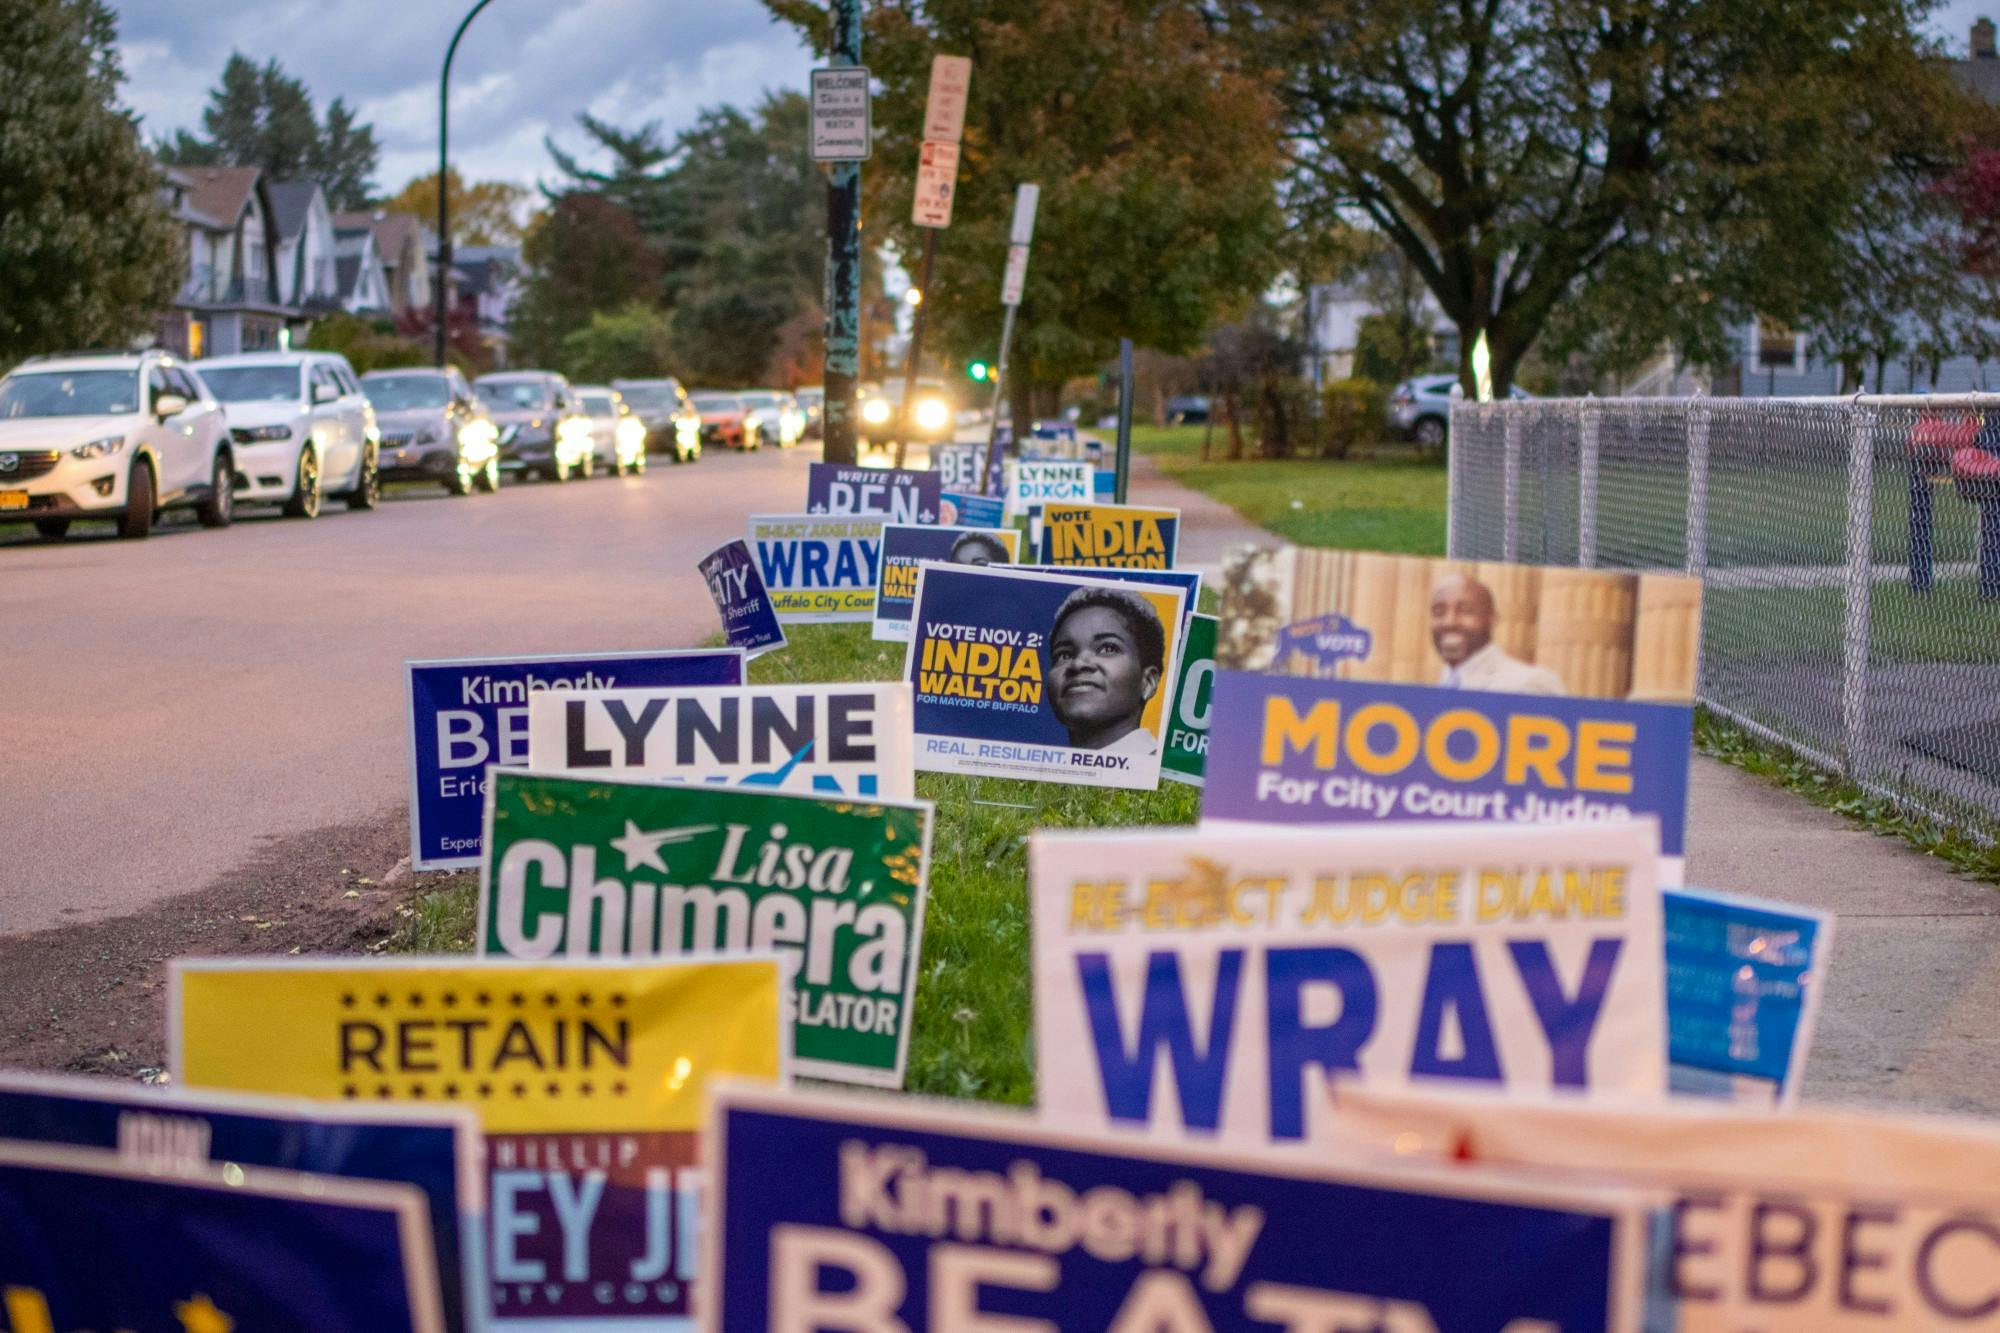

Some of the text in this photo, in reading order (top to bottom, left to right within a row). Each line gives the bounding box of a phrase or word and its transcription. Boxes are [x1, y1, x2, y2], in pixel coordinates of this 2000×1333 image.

[836, 470, 913, 485] WRITE IN
[1018, 467, 1085, 482] LYNNE
[1019, 482, 1086, 498] DIXON
[1051, 510, 1092, 522] VOTE
[1051, 520, 1165, 560] INDIA
[757, 540, 881, 588] WRAY
[886, 556, 912, 566] VOTE
[1053, 554, 1166, 569] TON
[727, 599, 761, 621] Sheriff
[771, 596, 811, 609] uffalo
[814, 594, 840, 611] City
[926, 622, 1043, 647] VOTE NOV. 2:
[1316, 634, 1365, 654] VOTE
[921, 638, 1043, 681] INDIA
[916, 694, 1039, 714] FOR MAYOR OF BUFFALO
[919, 671, 1042, 704] WALTON
[436, 707, 529, 770] BE
[566, 693, 876, 769] LYNNE
[1170, 729, 1210, 755] FOR
[1261, 696, 1637, 795] MOORE
[926, 739, 974, 756] REAL.
[978, 744, 1066, 764] RESILIENT.
[1070, 753, 1130, 770] READY.
[1256, 772, 1632, 826] For City Court Judge
[441, 836, 484, 853] Experi
[711, 822, 853, 894] Lisa
[1299, 868, 1461, 925] JUDGE
[1473, 863, 1632, 921] DIANE
[496, 838, 907, 995] Chimera
[339, 1019, 631, 1075] RETAIN
[1073, 937, 1626, 1143] WRAY
[492, 1169, 607, 1283] EY
[838, 1139, 1266, 1292] Kimberly
